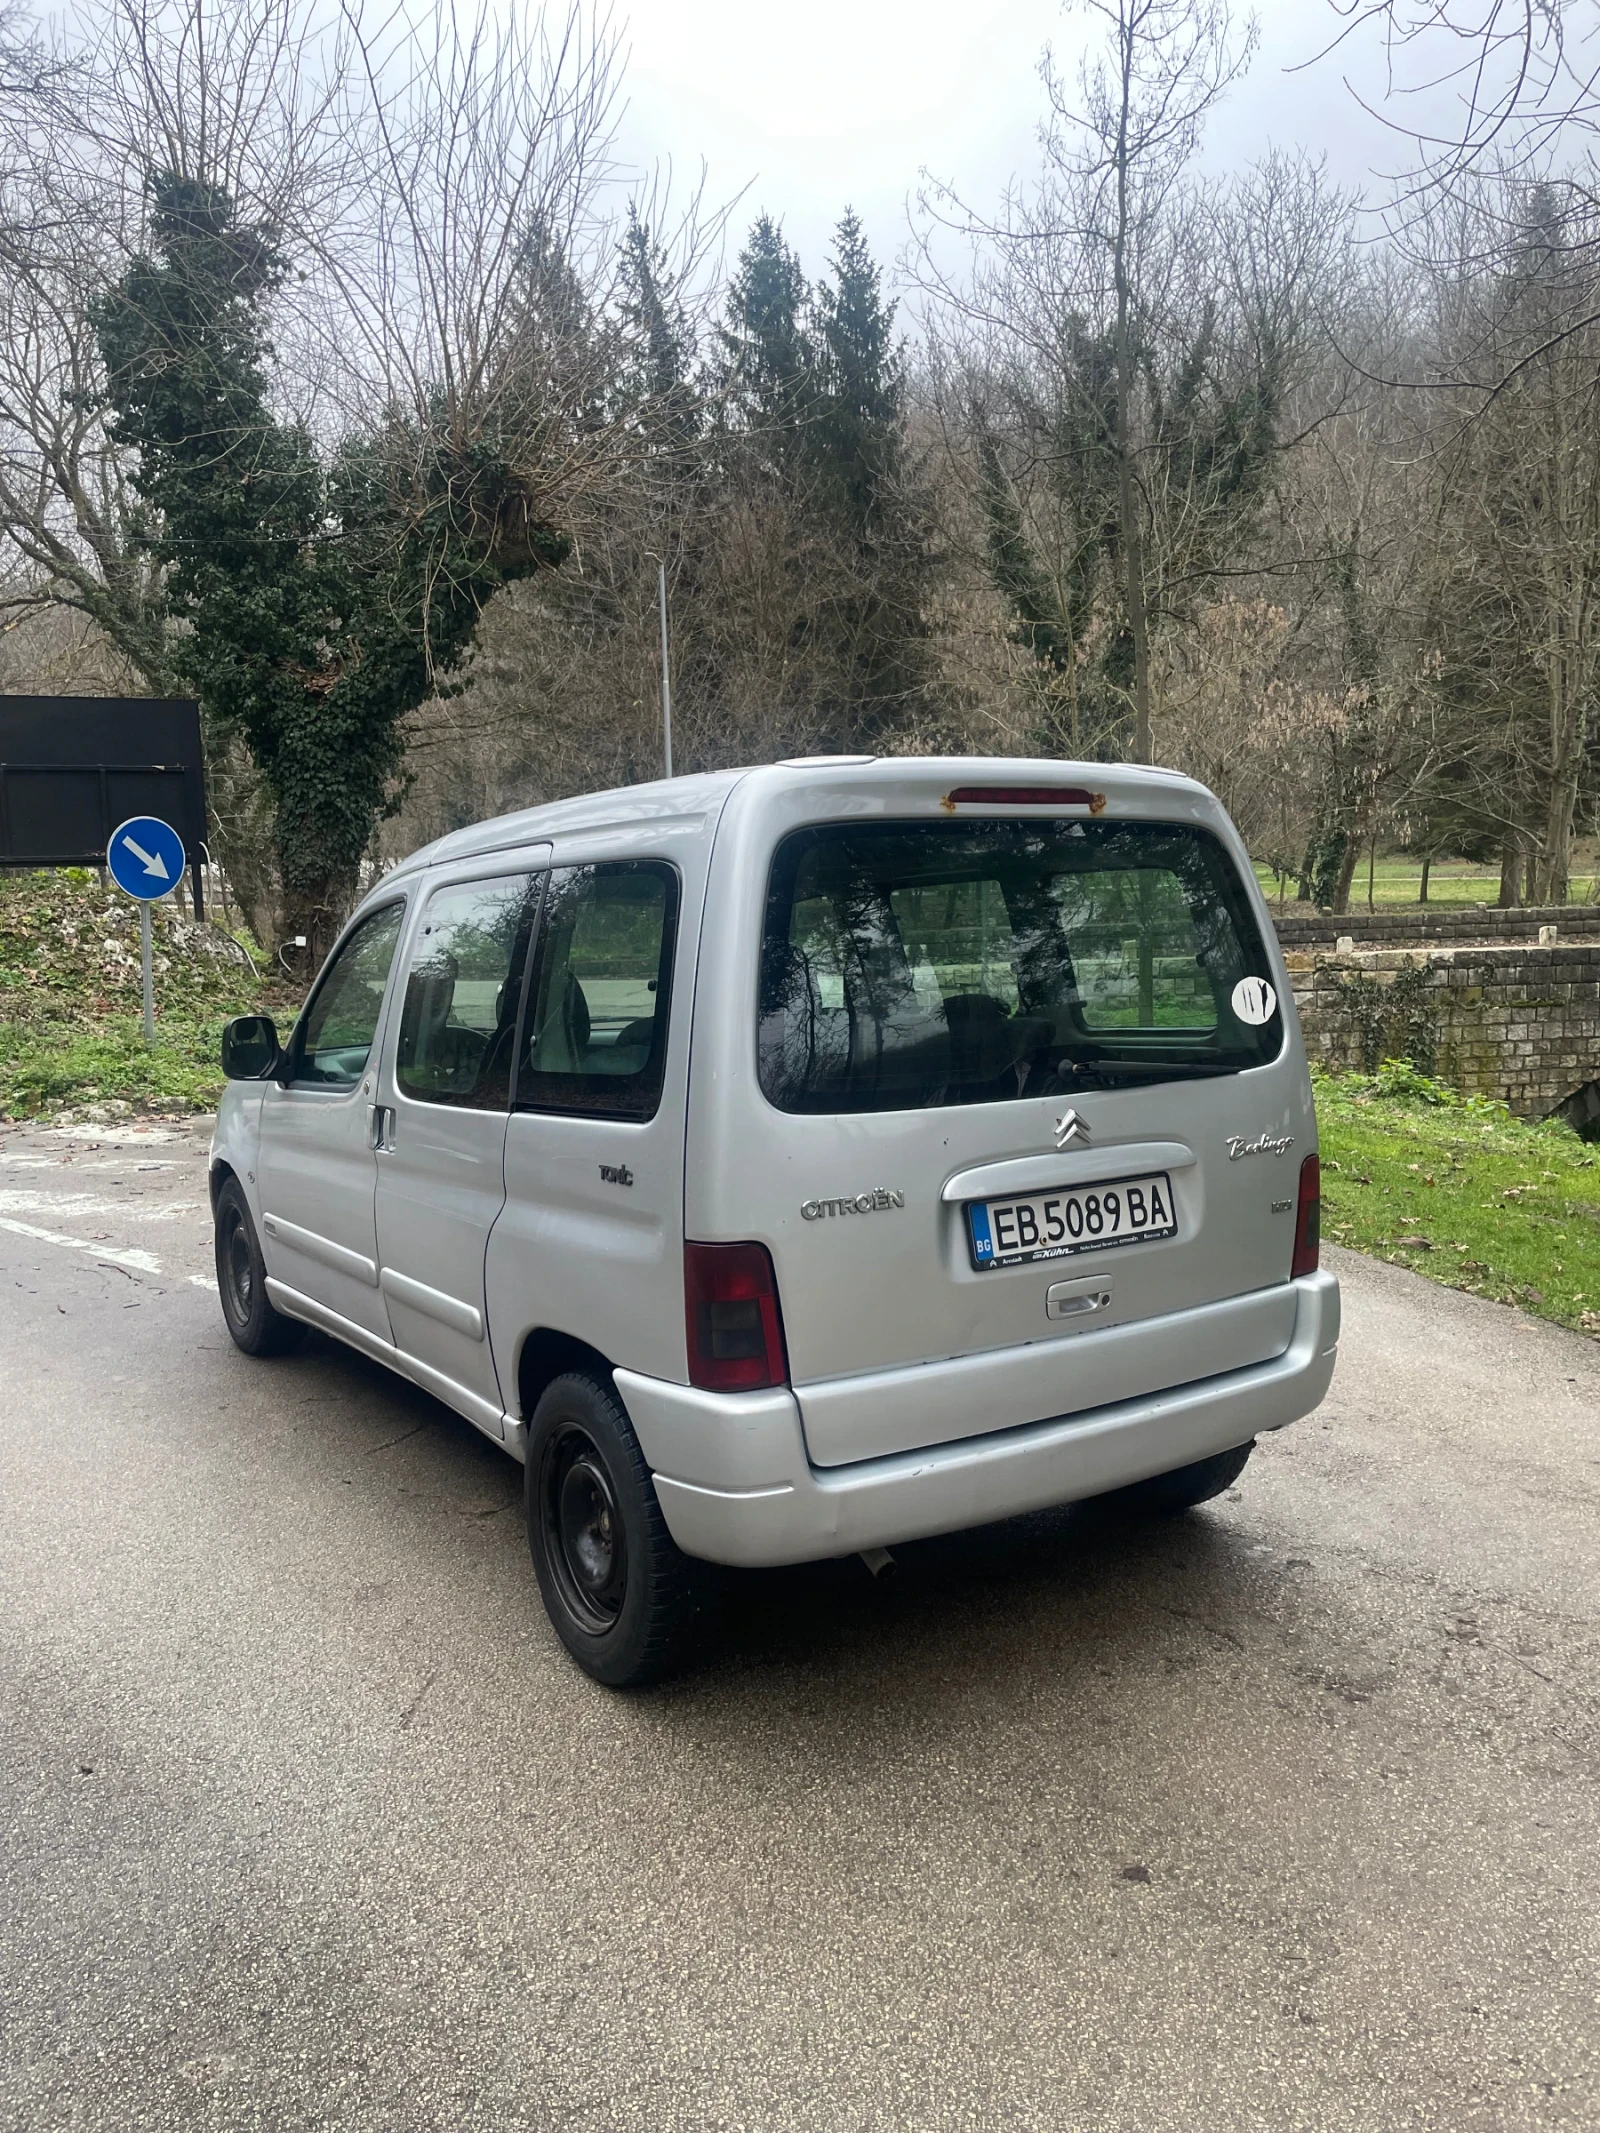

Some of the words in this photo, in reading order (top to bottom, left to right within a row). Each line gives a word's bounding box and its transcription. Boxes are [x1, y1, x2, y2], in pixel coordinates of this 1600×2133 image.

[1225, 1133, 1295, 1161] Berlingo
[801, 1186, 905, 1220] CITROËN
[1126, 1185, 1168, 1227] BA
[976, 1239, 991, 1253] BG
